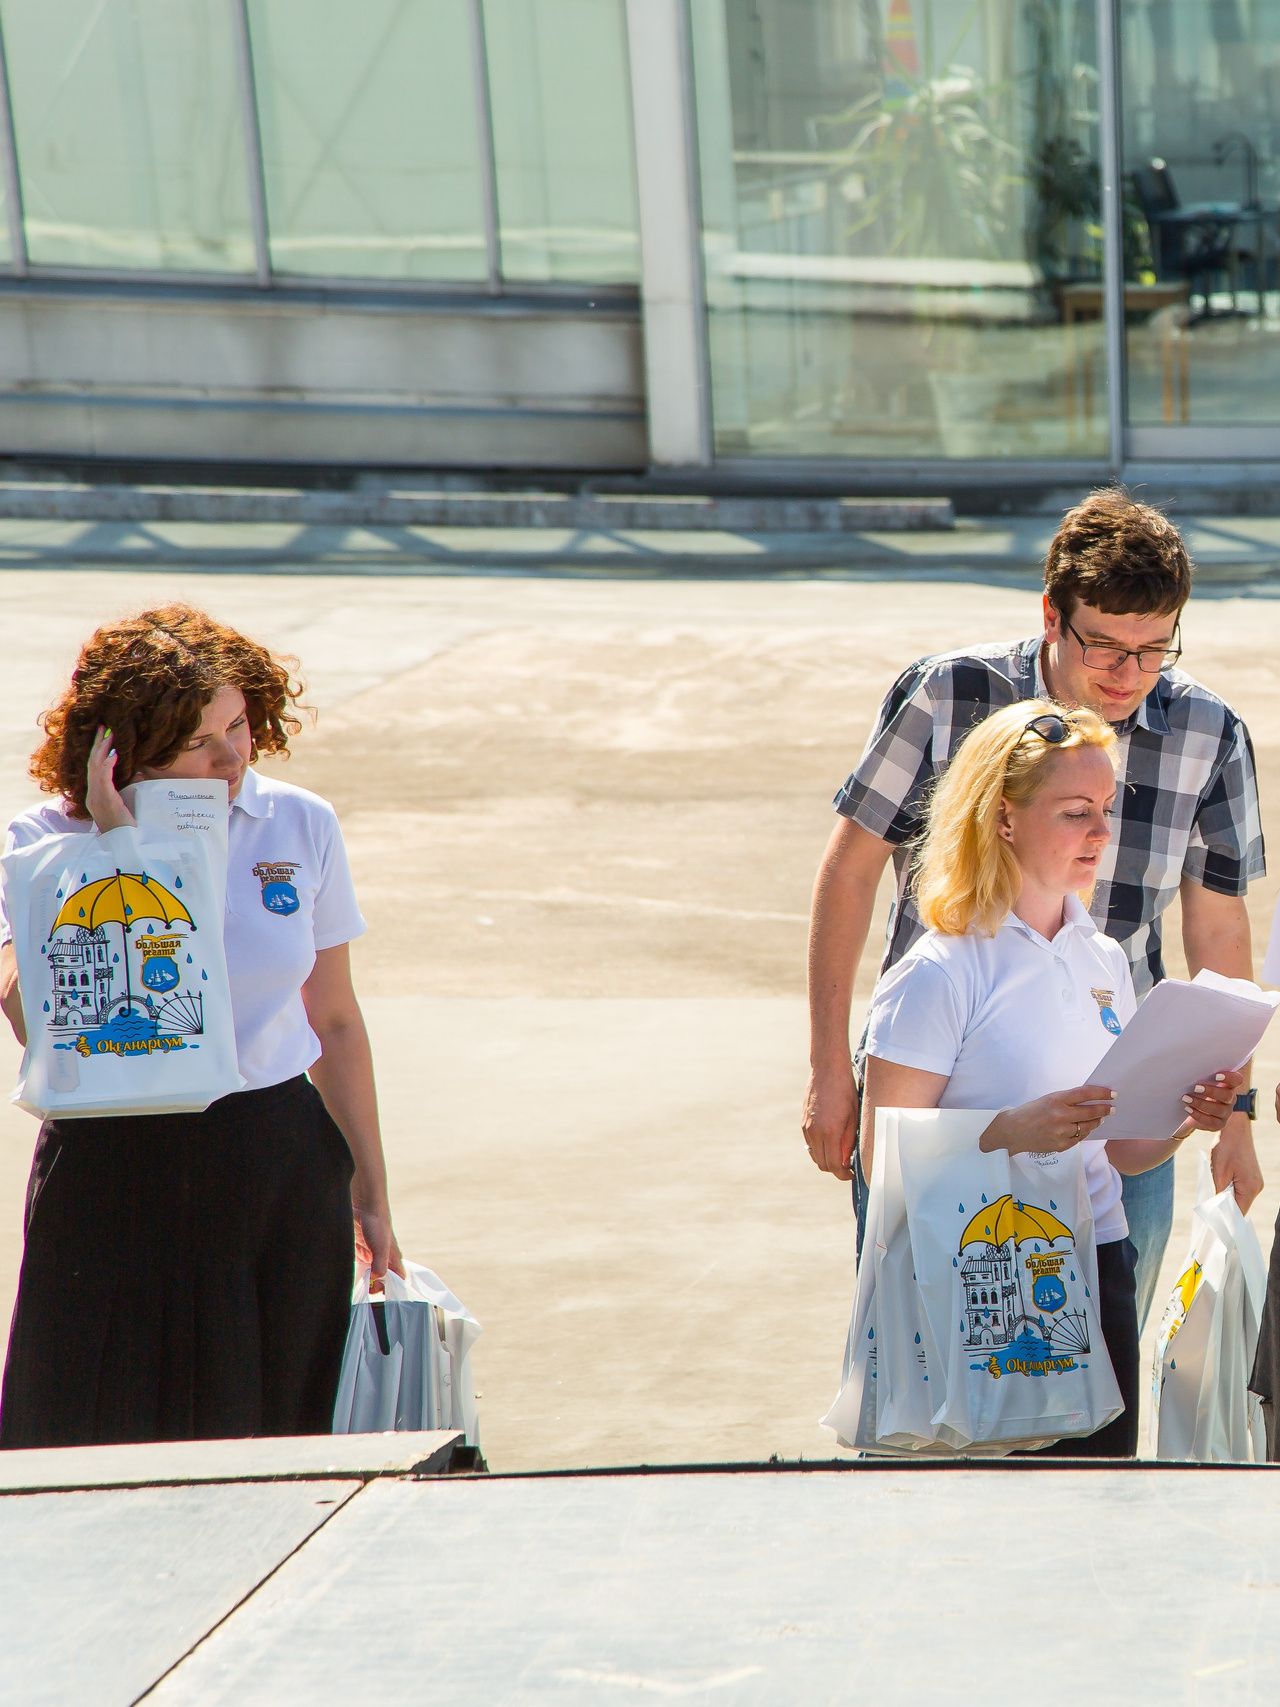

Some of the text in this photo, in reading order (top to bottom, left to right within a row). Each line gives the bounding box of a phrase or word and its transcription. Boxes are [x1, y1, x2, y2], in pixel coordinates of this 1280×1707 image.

[135, 939, 181, 950] Большая
[143, 948, 176, 957] регата
[1025, 1257, 1065, 1270] Большая
[1032, 1266, 1061, 1276] регата
